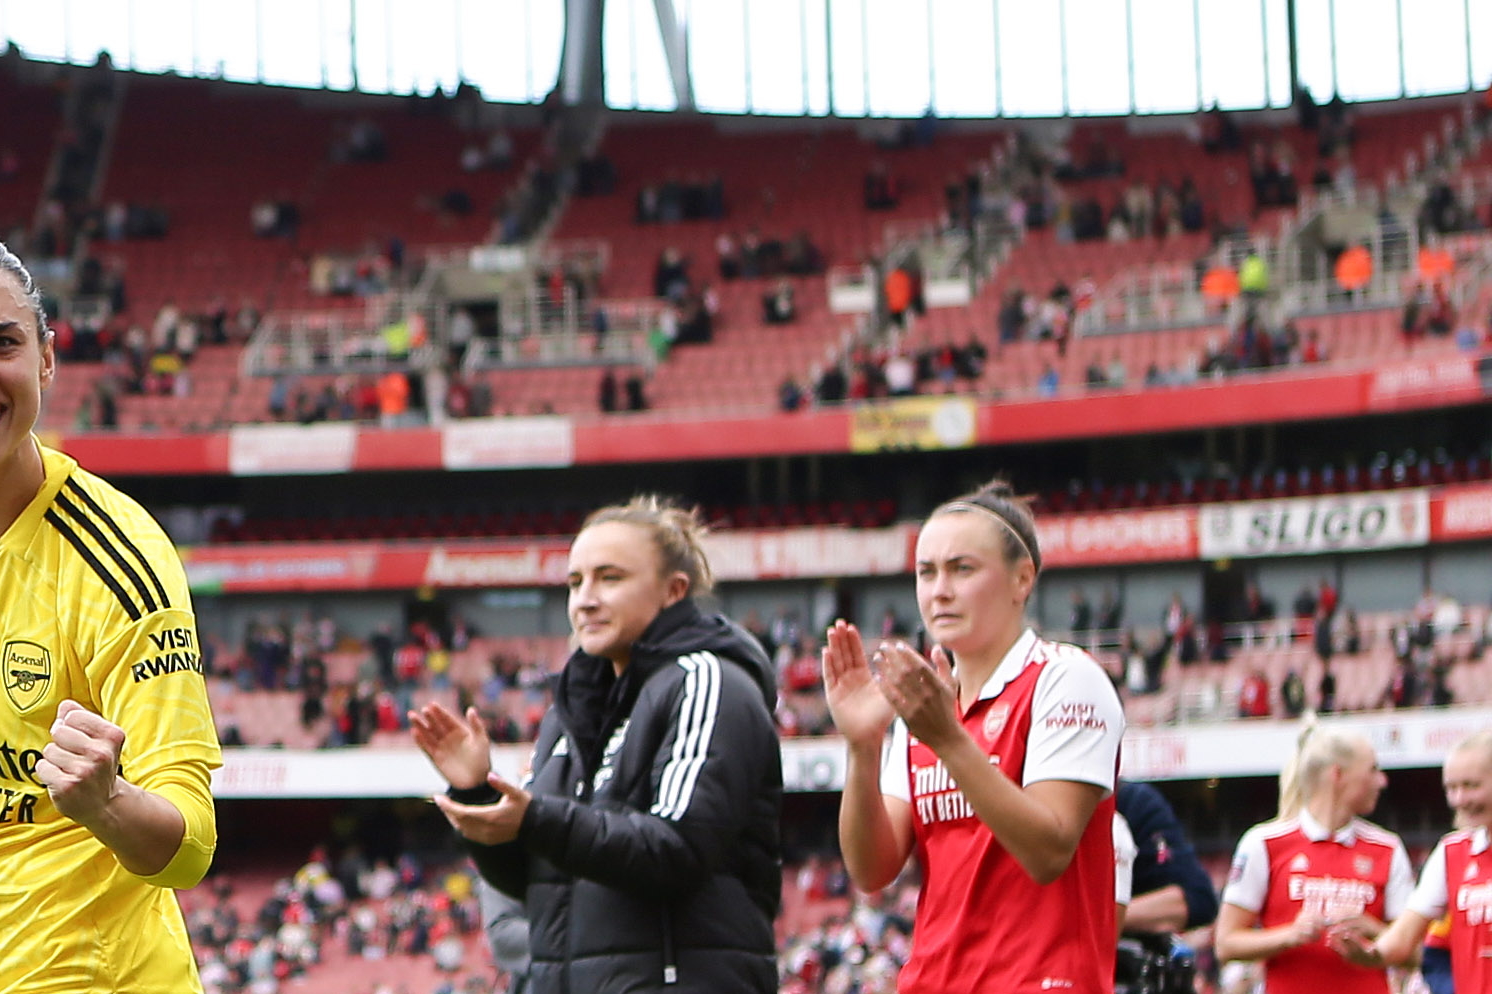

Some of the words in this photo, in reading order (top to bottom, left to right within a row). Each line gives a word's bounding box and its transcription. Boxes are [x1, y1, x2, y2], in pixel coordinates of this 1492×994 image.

[1247, 505, 1387, 547] SLIGO
[10, 652, 44, 667] Arsenal
[1061, 703, 1095, 715] VISIT
[1045, 717, 1107, 731] RWANDA
